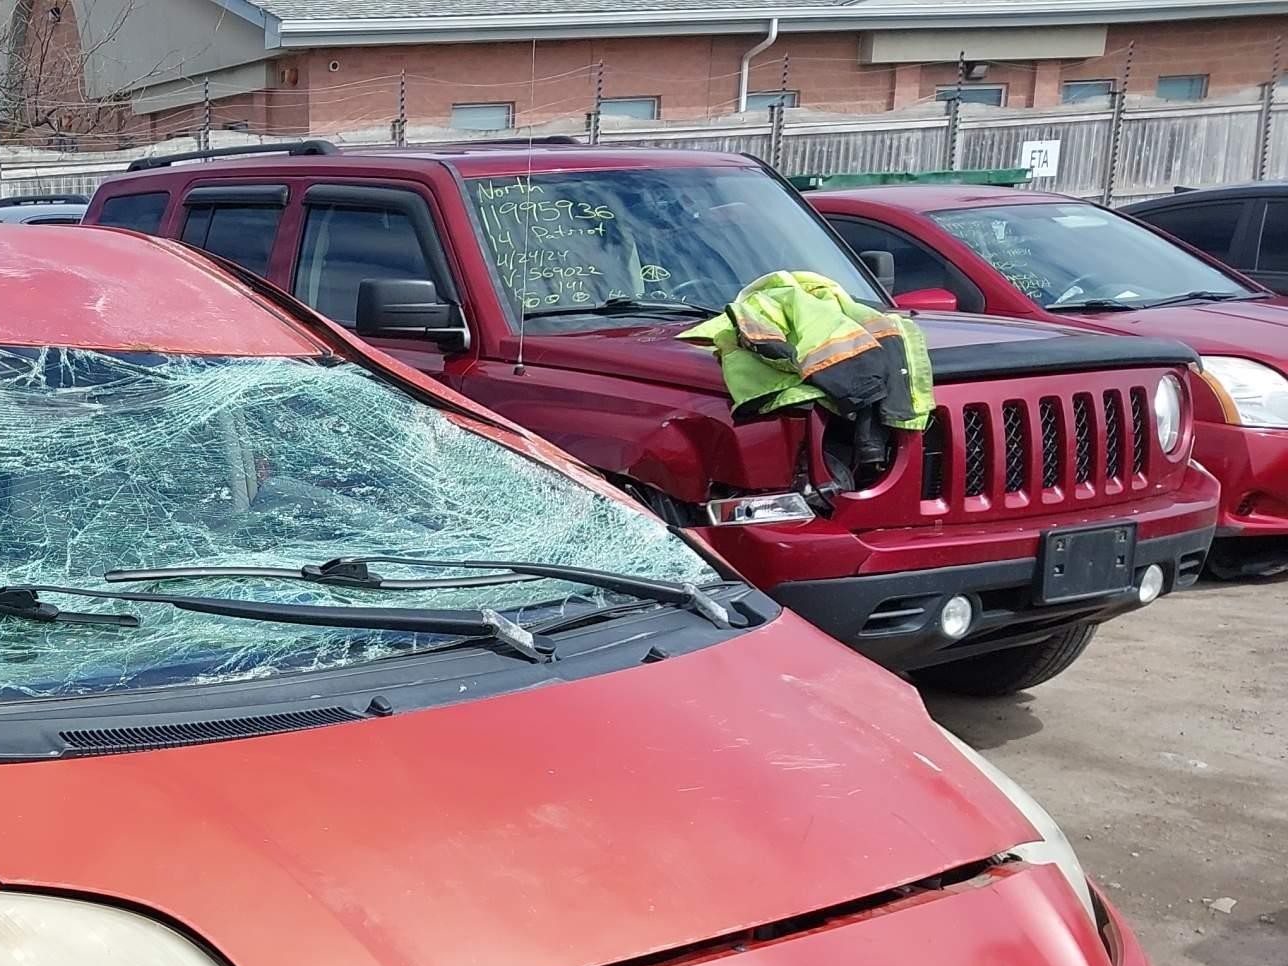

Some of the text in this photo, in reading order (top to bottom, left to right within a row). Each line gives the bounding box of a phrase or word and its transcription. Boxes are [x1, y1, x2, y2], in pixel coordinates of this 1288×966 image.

[1030, 150, 1049, 168] ETA
[478, 176, 544, 203] North
[480, 200, 616, 231] 11995936
